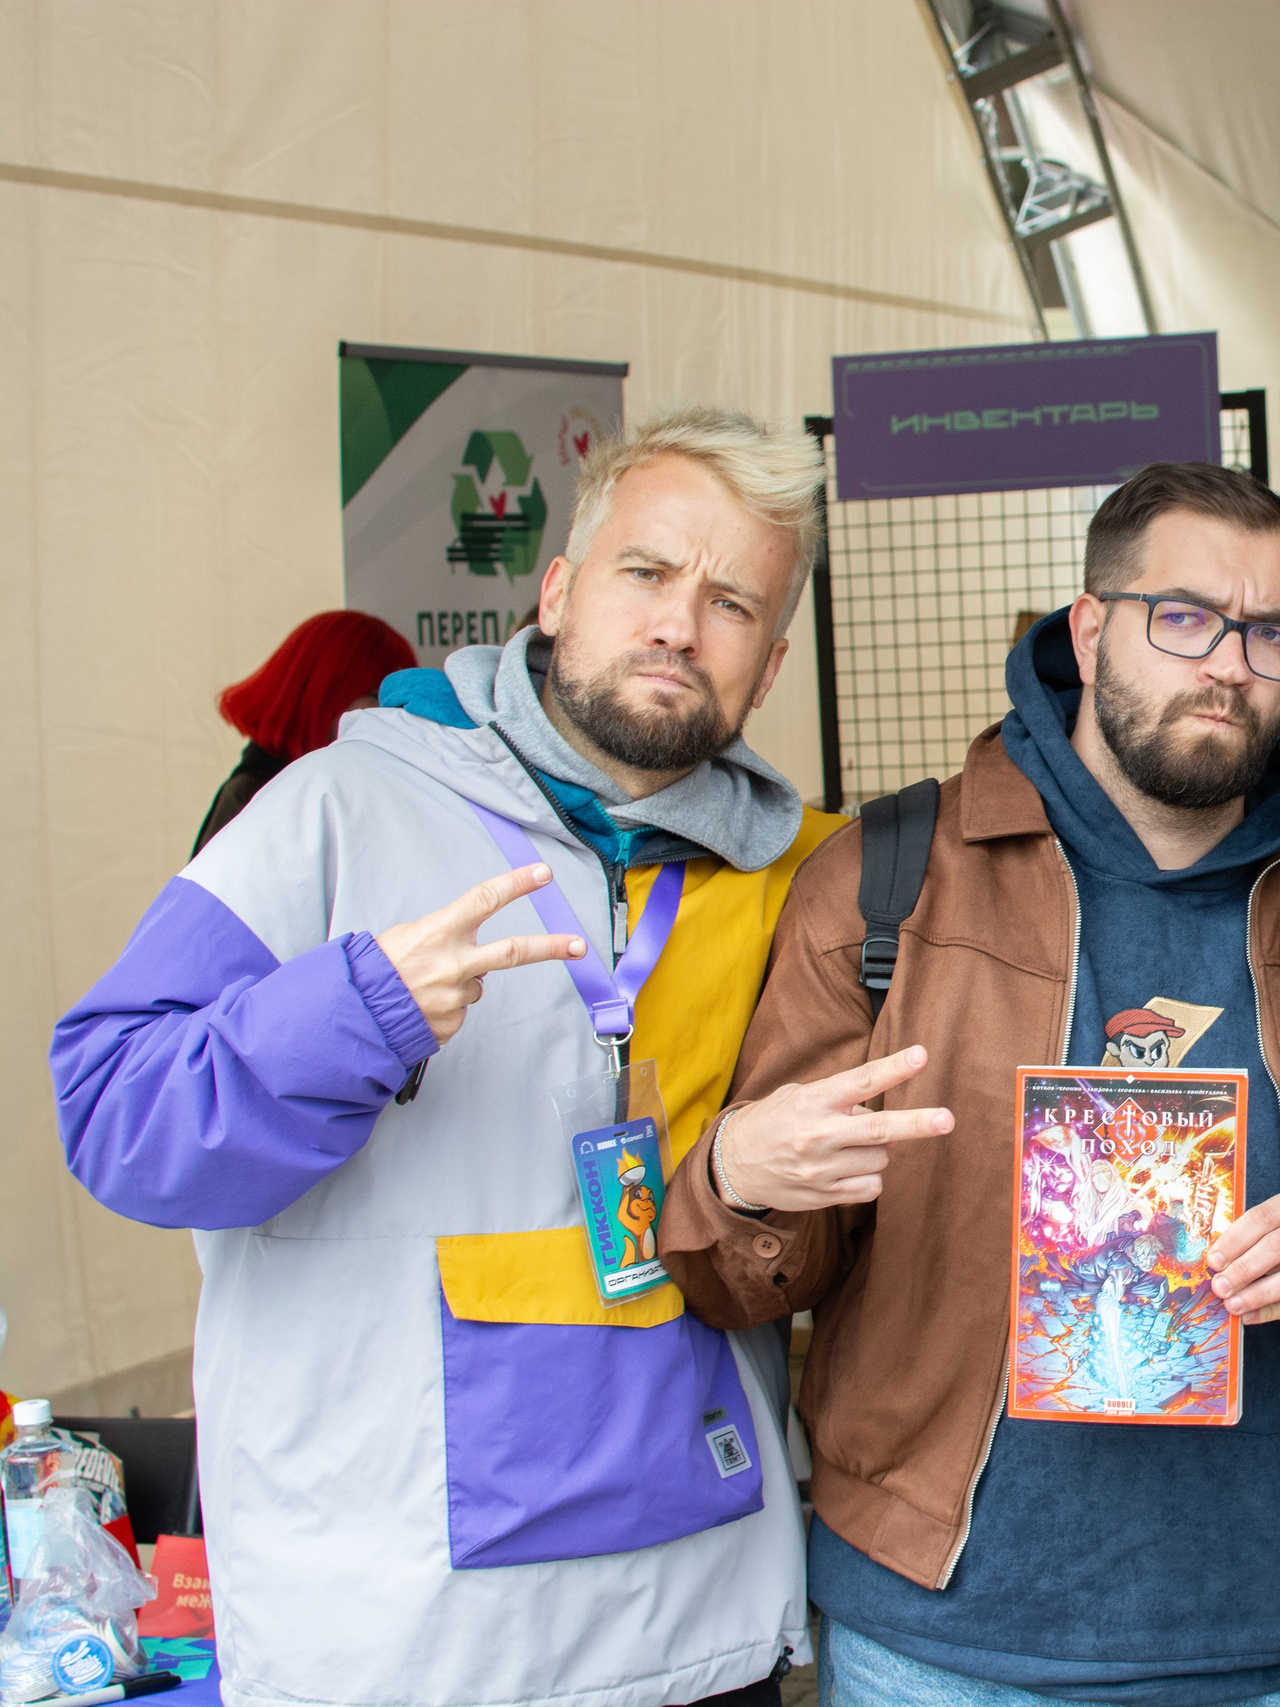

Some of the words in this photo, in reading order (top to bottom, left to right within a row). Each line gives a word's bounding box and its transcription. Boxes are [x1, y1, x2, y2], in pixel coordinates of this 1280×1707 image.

[891, 401, 1160, 435] ИНВЕНТАРЬ
[1044, 1104, 1214, 1138] КРЕСТОВЫЙ
[1081, 1138, 1176, 1157] ПОХОД
[583, 1160, 618, 1267] ГИККОН
[608, 1264, 666, 1287] ОРГАНИЗАТ
[1107, 1400, 1133, 1408] BUBBLE
[176, 1593, 213, 1609] меж
